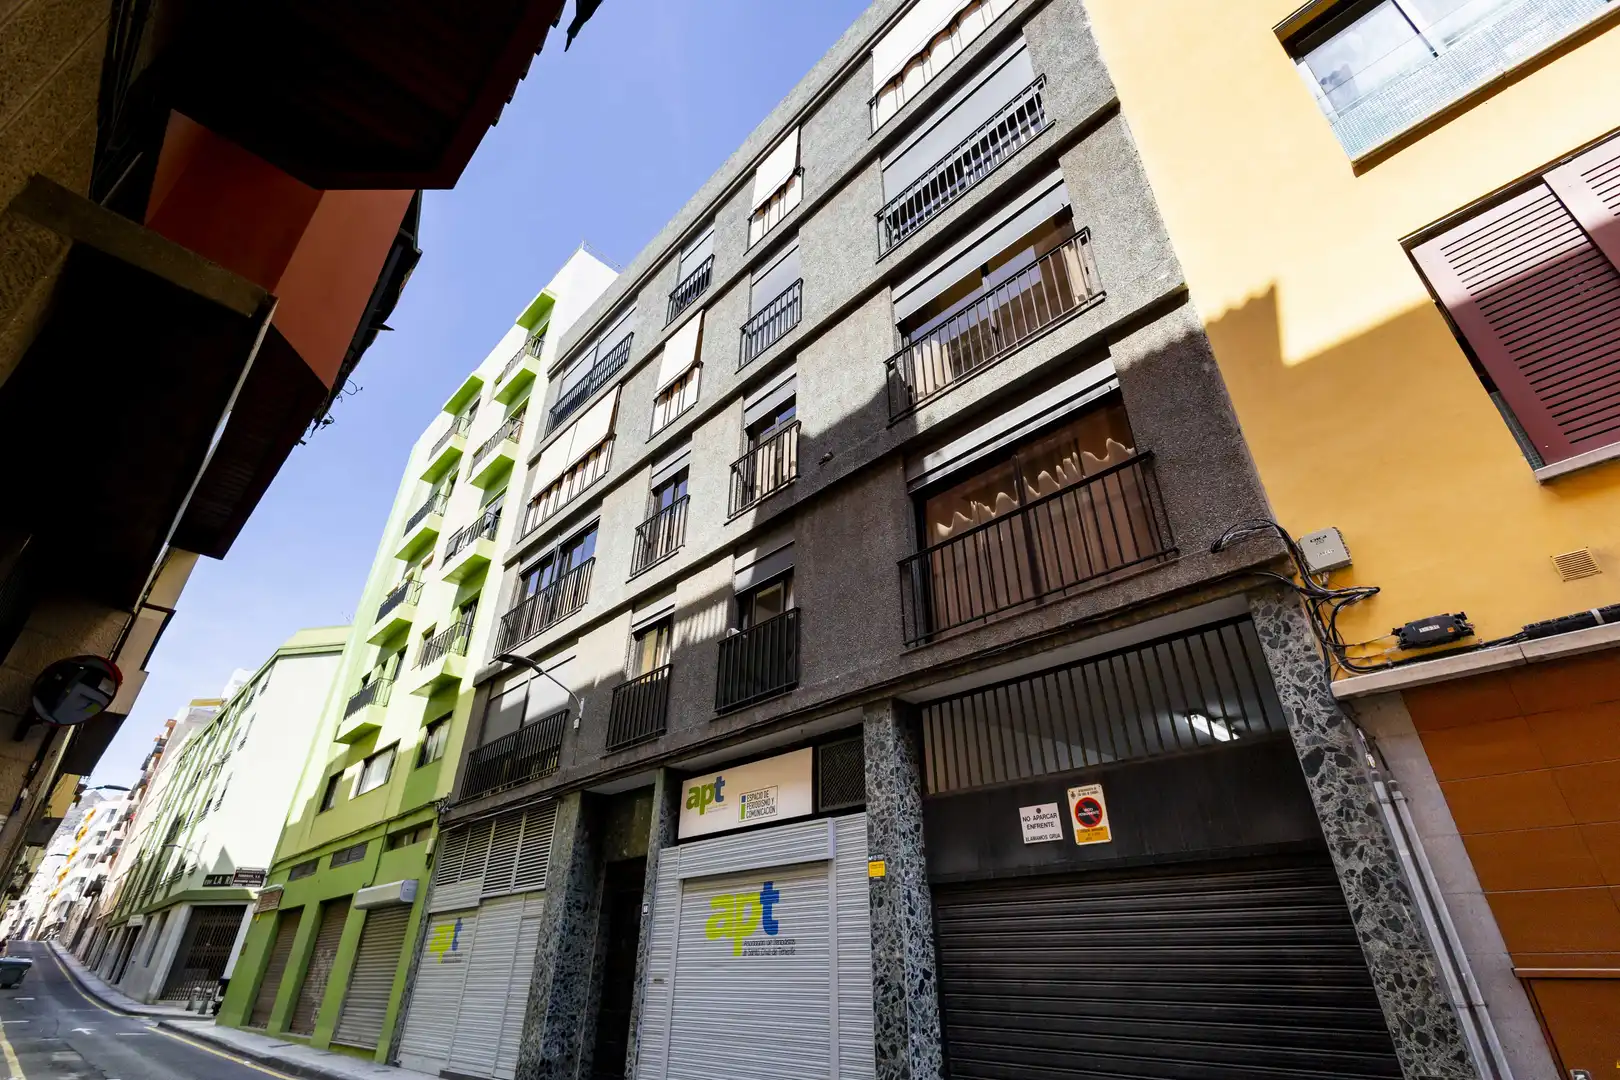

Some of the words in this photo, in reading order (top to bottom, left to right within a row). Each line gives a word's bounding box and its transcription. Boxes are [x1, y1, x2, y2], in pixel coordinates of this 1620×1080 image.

[686, 776, 725, 815] apt
[747, 791, 763, 802] ESPACIO
[764, 790, 769, 798] DE
[746, 798, 771, 810] PERIODISMO
[1033, 813, 1058, 821] APARCAR
[1027, 822, 1055, 830] ENFRENTE
[705, 881, 779, 956] apt
[430, 917, 463, 964] apt
